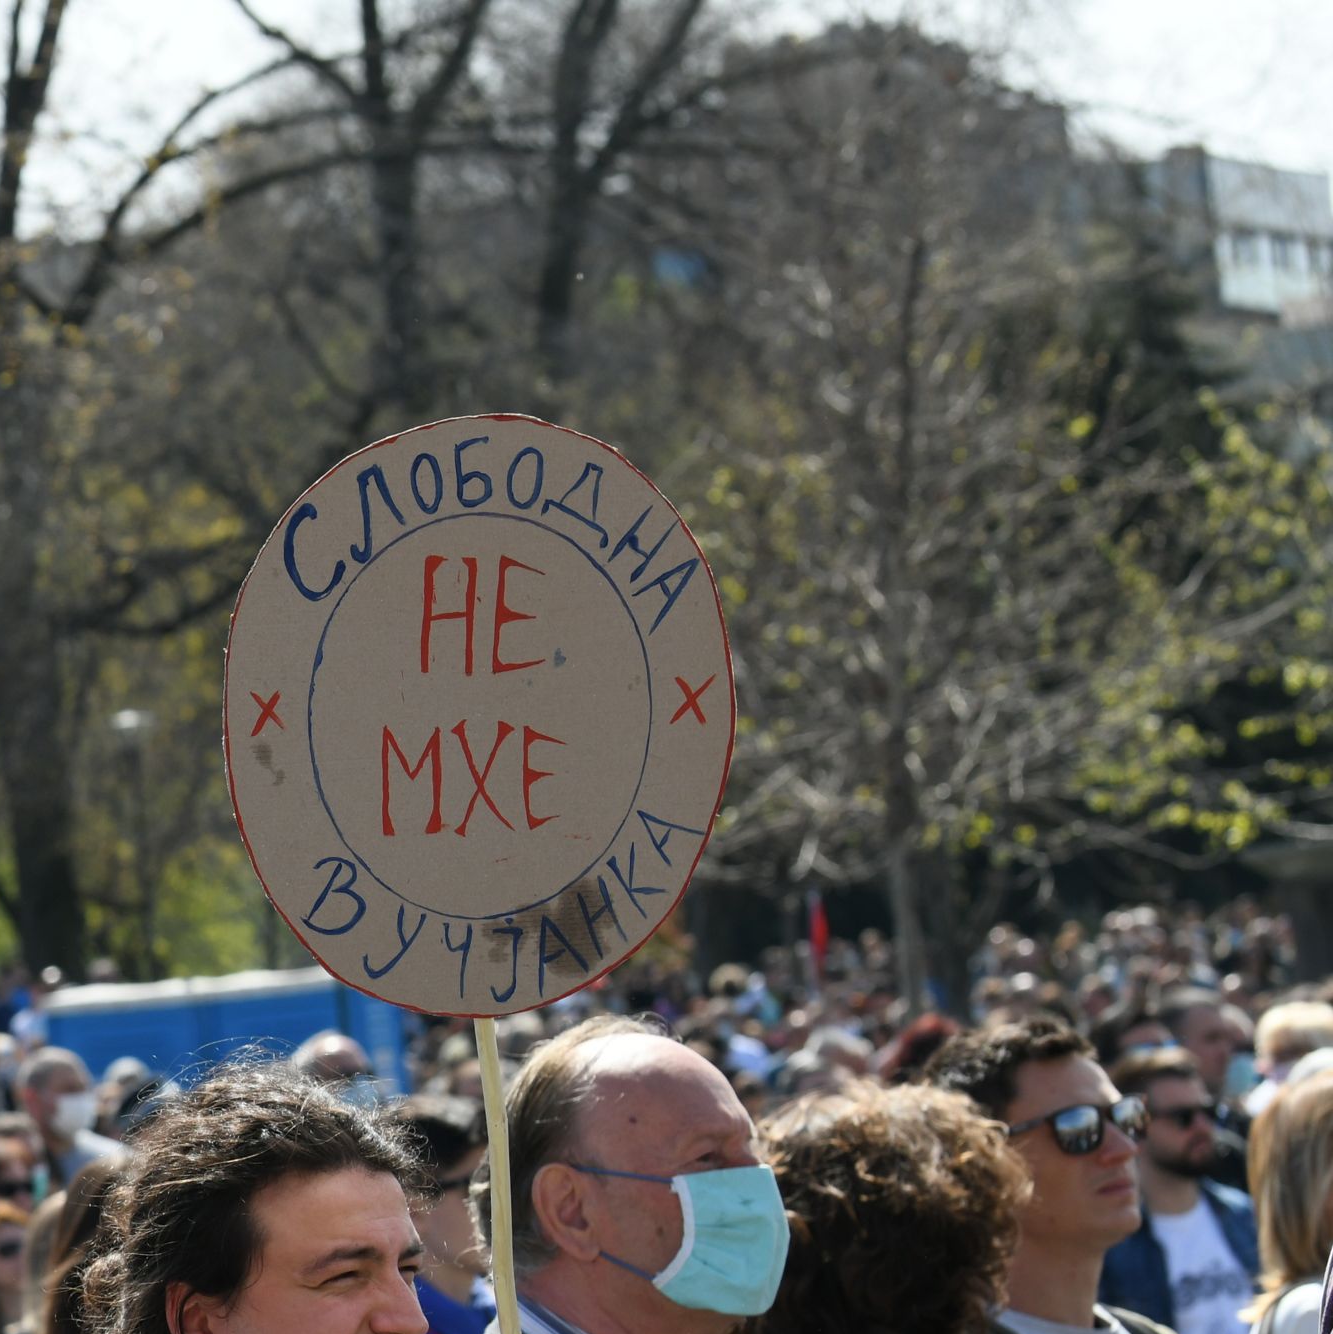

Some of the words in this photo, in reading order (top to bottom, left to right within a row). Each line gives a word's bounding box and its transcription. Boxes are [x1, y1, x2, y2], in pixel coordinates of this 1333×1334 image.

[283, 435, 700, 636] СЛОБОДНА
[419, 554, 547, 677] НЕ
[381, 718, 568, 838] МХЕ
